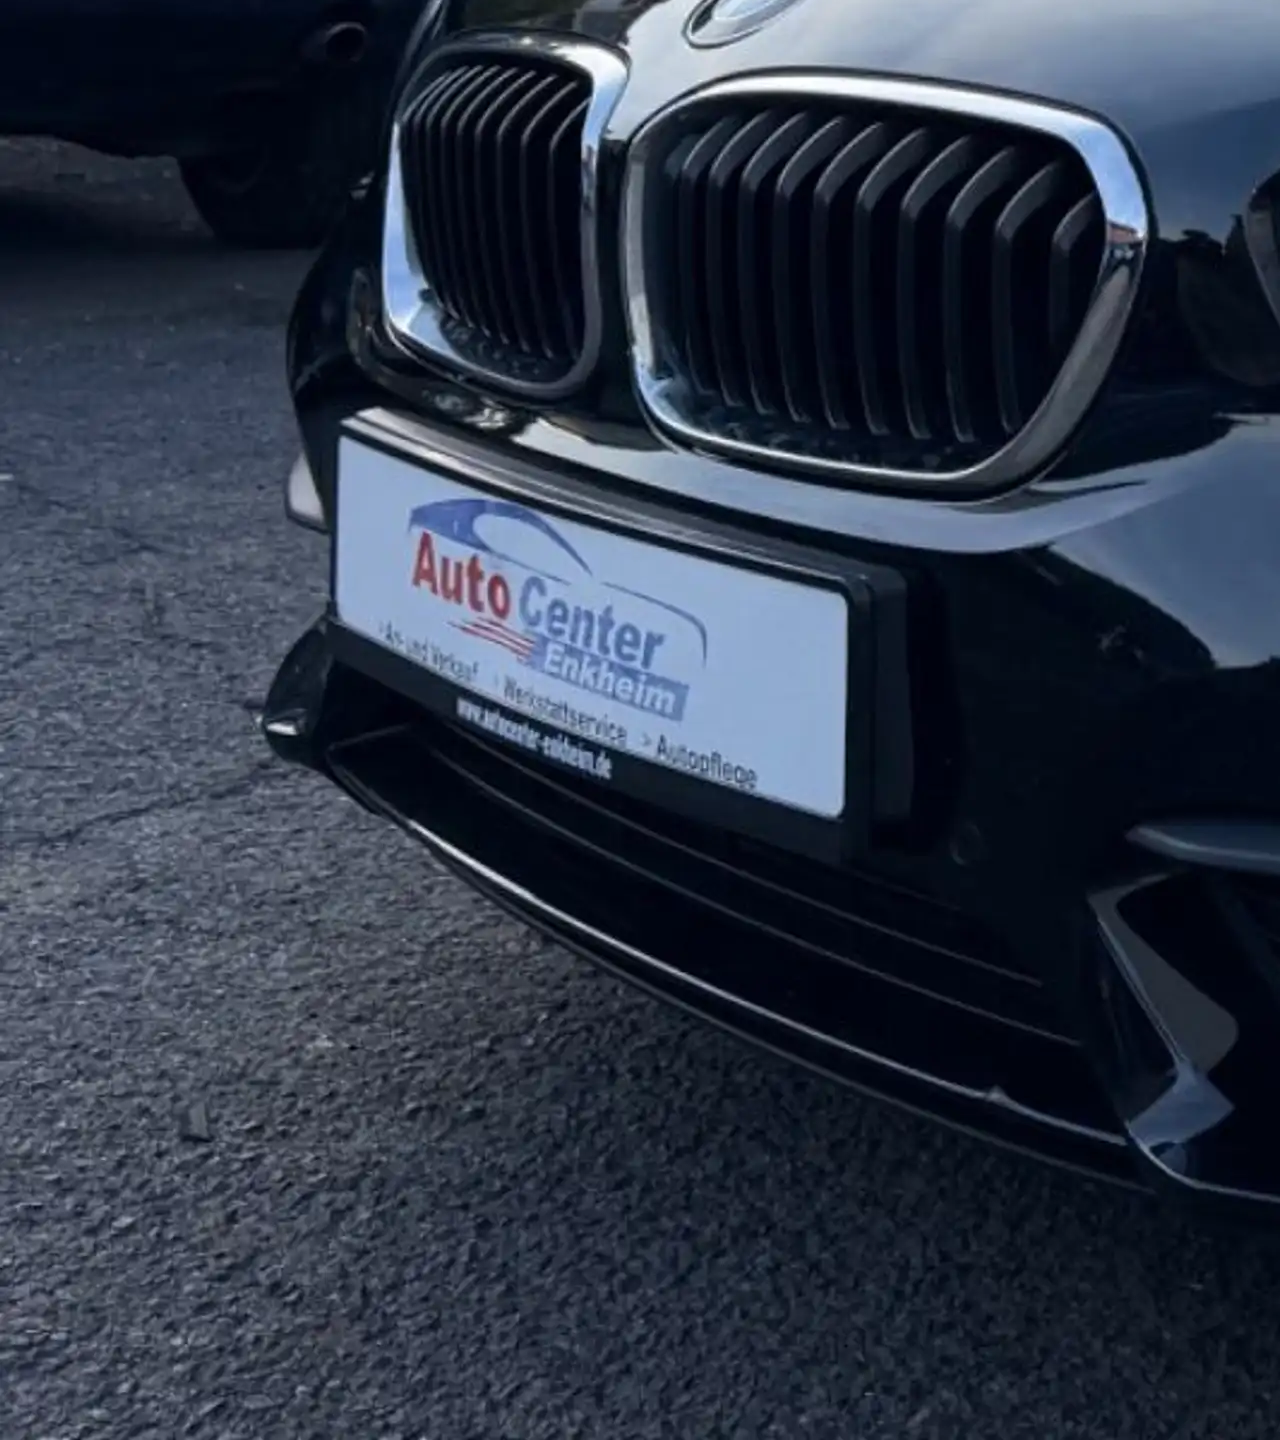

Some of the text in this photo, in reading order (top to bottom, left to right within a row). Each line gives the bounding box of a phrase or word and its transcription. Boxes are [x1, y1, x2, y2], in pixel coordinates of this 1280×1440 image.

[412, 530, 664, 669] Auto Center
[544, 642, 677, 714] Enkheim
[657, 734, 759, 791] Autopflege
